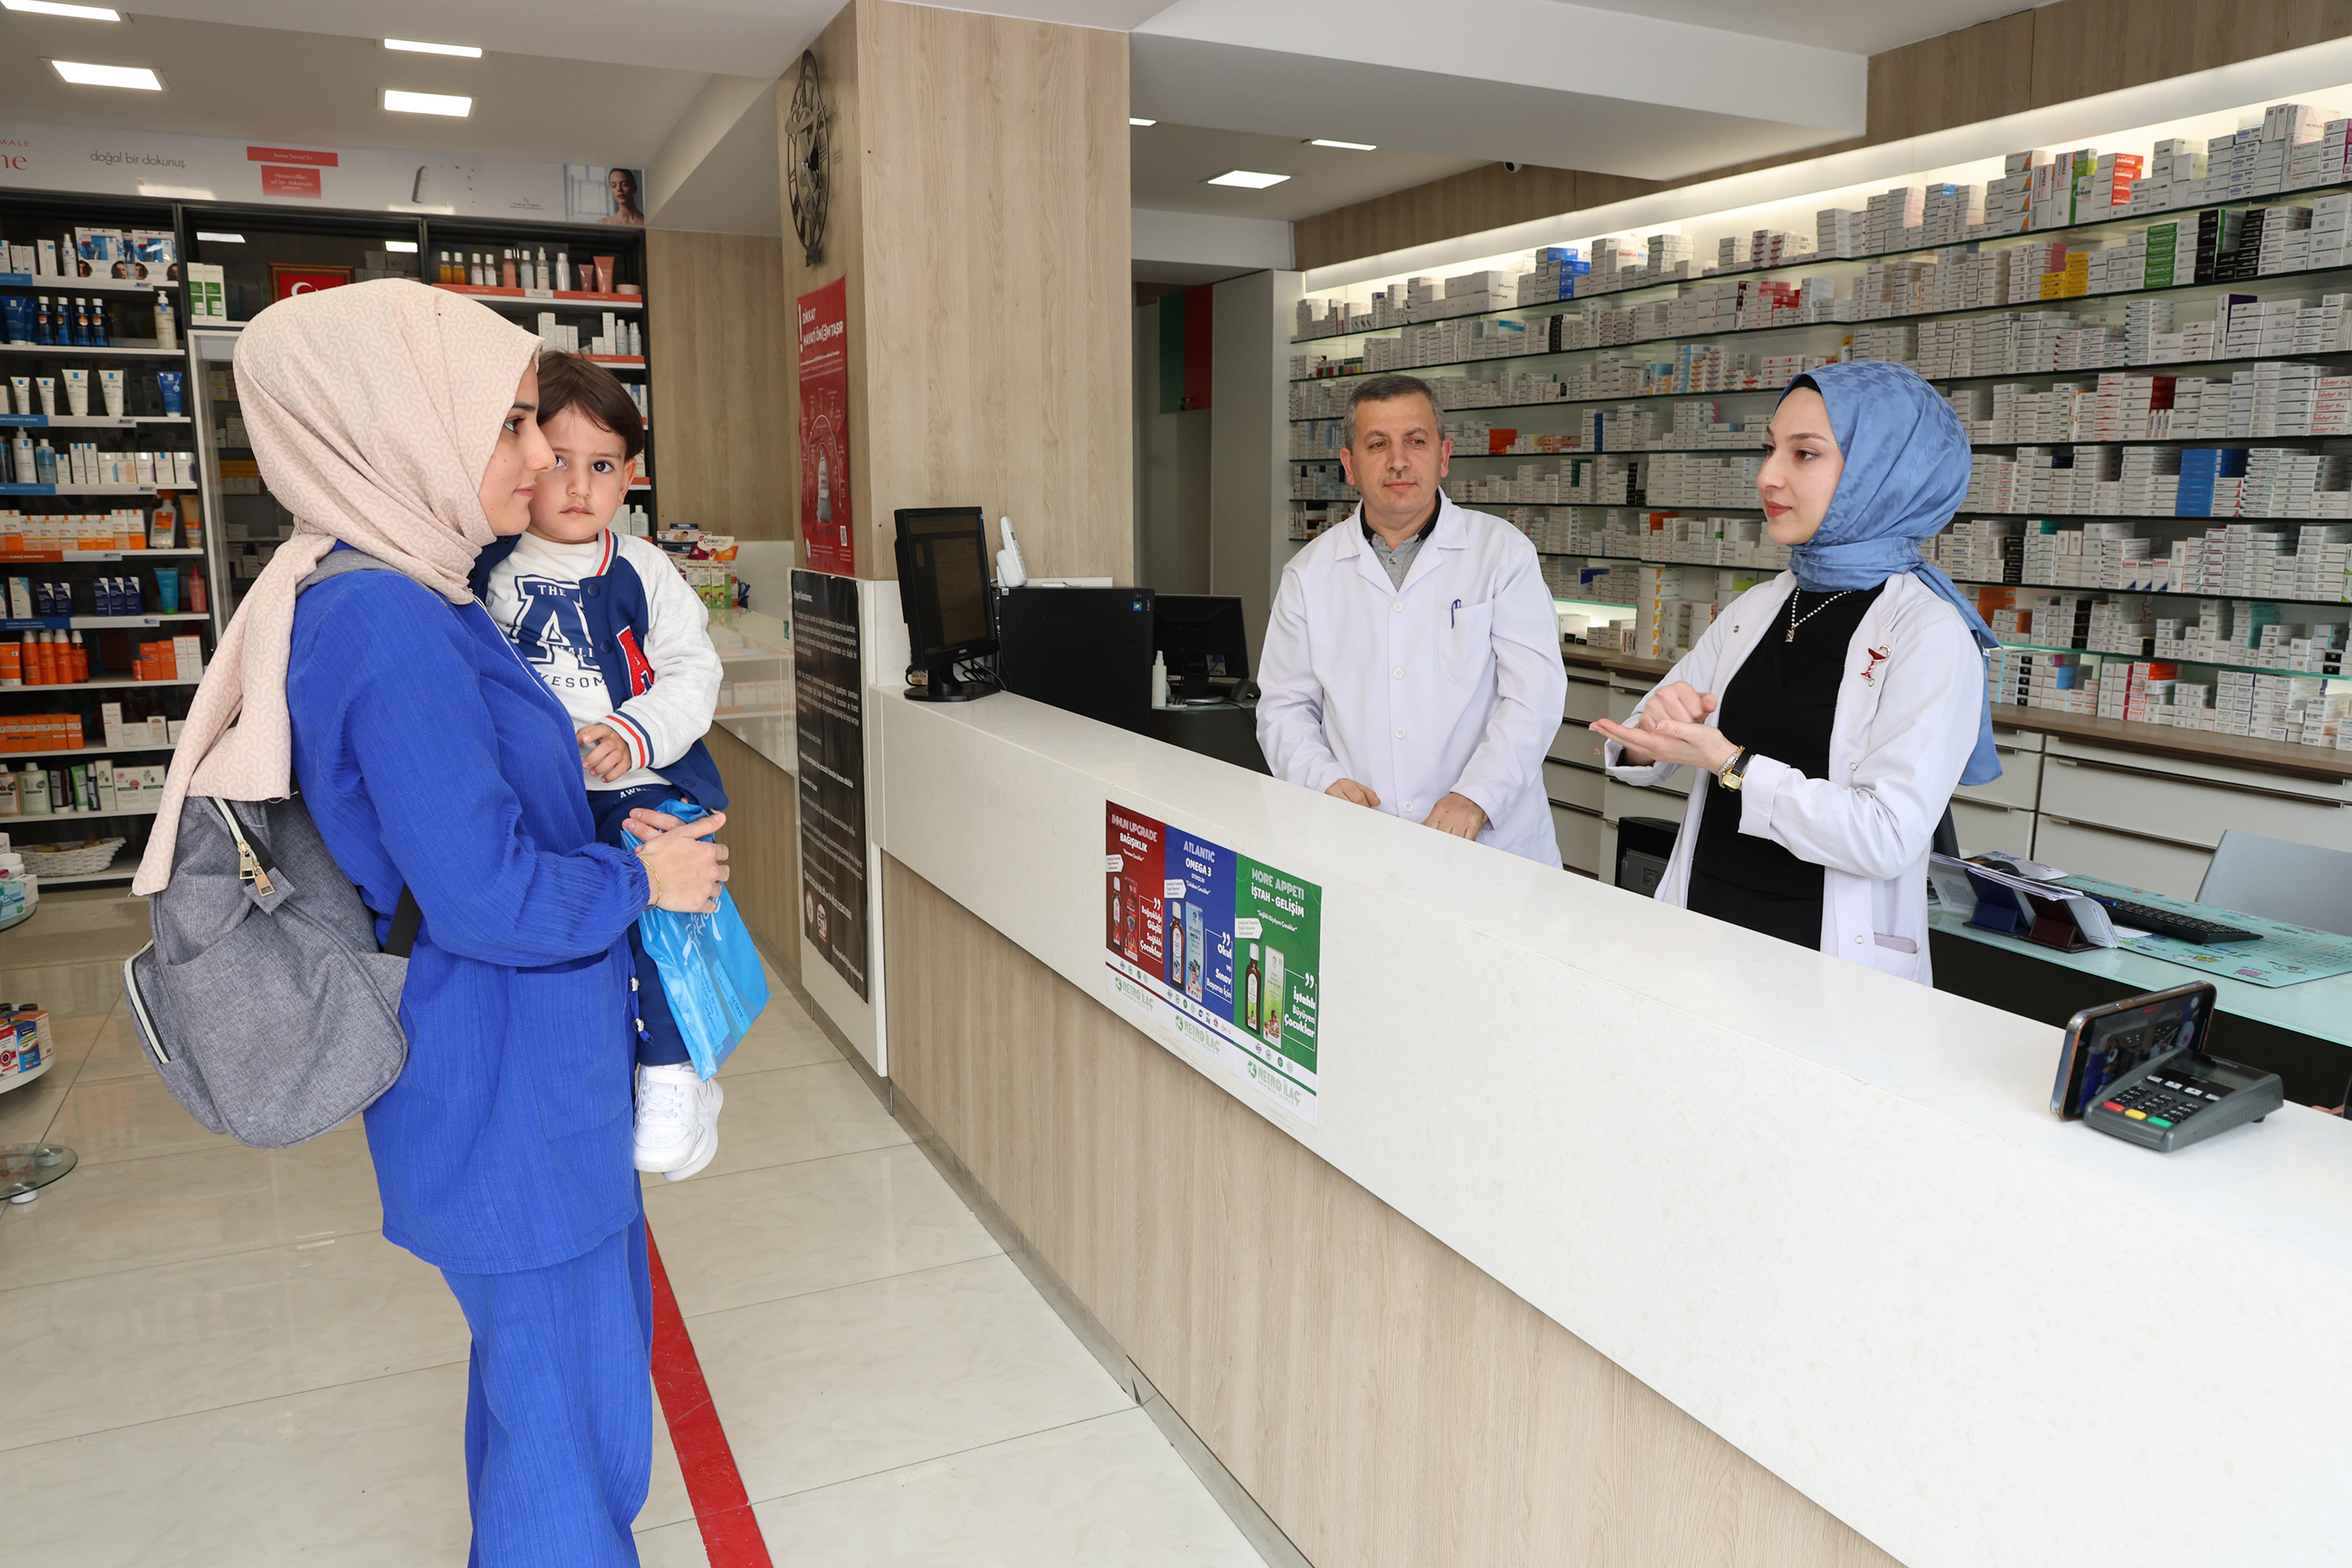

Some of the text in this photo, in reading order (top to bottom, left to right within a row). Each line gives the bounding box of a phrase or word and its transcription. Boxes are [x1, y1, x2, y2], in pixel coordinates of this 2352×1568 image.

[90, 150, 185, 168] doğal bir dokunuş
[803, 308, 816, 324] DİKKAT
[803, 320, 843, 346] HAYATİ ÖNEM TAŞIR
[538, 584, 565, 597] THE
[616, 625, 655, 697] A
[1112, 814, 1157, 842] IMMUN UPGRADE
[1120, 833, 1148, 852] BAĞIŞIKLIK
[1183, 840, 1215, 863] ATLANTIC
[1186, 858, 1212, 877] OMEGA 3
[1252, 868, 1304, 900] MORE APPETI
[1251, 882, 1271, 903] İŞTAH
[1275, 896, 1304, 918] GELİŞİM
[1147, 920, 1162, 934] Güçlü
[1140, 940, 1162, 959] Çocuklar
[1217, 943, 1232, 959] Okul
[1215, 968, 1232, 985] Sınav
[1226, 964, 1232, 972] ve
[1123, 981, 1141, 1000] RETRO
[1141, 990, 1154, 1009] İLAÇ
[1293, 985, 1315, 1010] İştahlı
[1292, 1004, 1315, 1024] Büyüyen
[1284, 1013, 1315, 1038] Çocuklar
[1184, 1020, 1204, 1042] RETRO
[1205, 1031, 1220, 1053] İLAÇ
[1258, 1067, 1282, 1092] RETRO
[1283, 1079, 1300, 1106] İLAÇ
